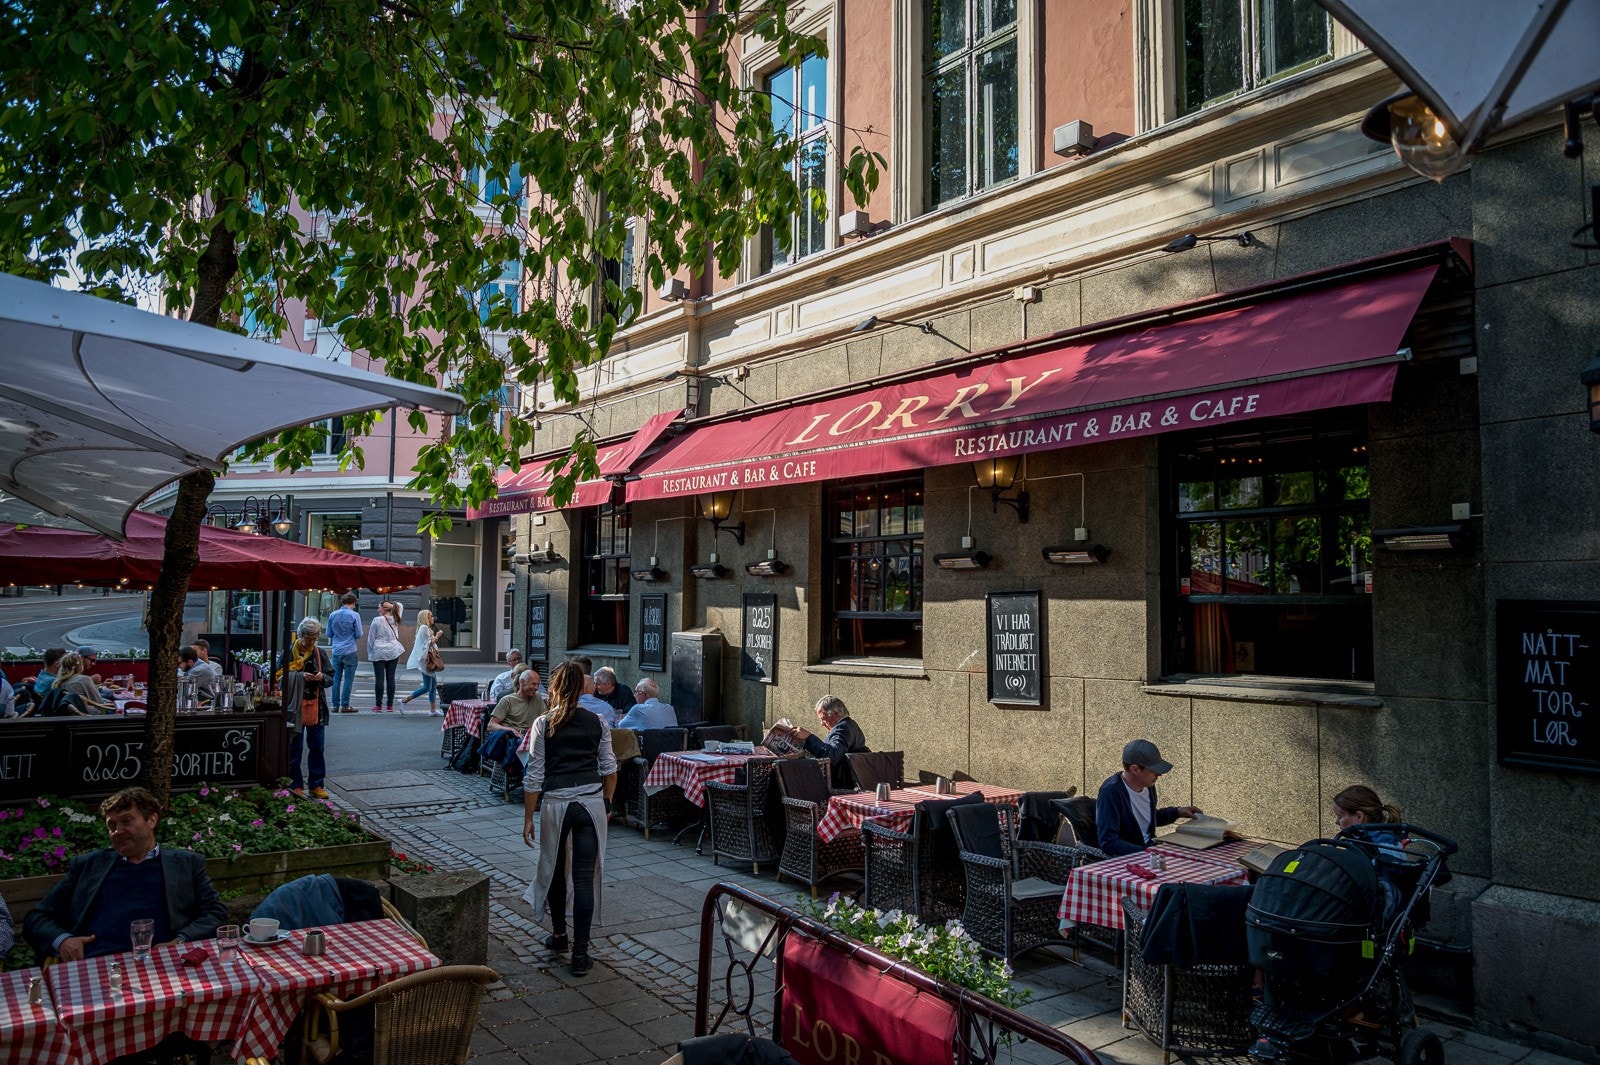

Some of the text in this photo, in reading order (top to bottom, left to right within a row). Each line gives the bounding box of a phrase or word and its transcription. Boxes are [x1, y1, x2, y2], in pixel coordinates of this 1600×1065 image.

[785, 367, 1063, 446] LORRY
[954, 394, 1260, 457] RESTAURANT & BAR & CAFE
[663, 461, 817, 493] RESTAURANT & BAR & CAFE
[488, 498, 529, 513] RESTAURANT
[537, 497, 550, 508] BAR
[752, 607, 771, 629] 225
[996, 613, 1031, 630] VI HAR
[994, 632, 1035, 651] TRÅDLØST
[995, 653, 1037, 671] INTERNETT
[1524, 660, 1570, 685] MAT
[1533, 718, 1577, 746] LØR
[82, 742, 236, 781] 225 SORTER
